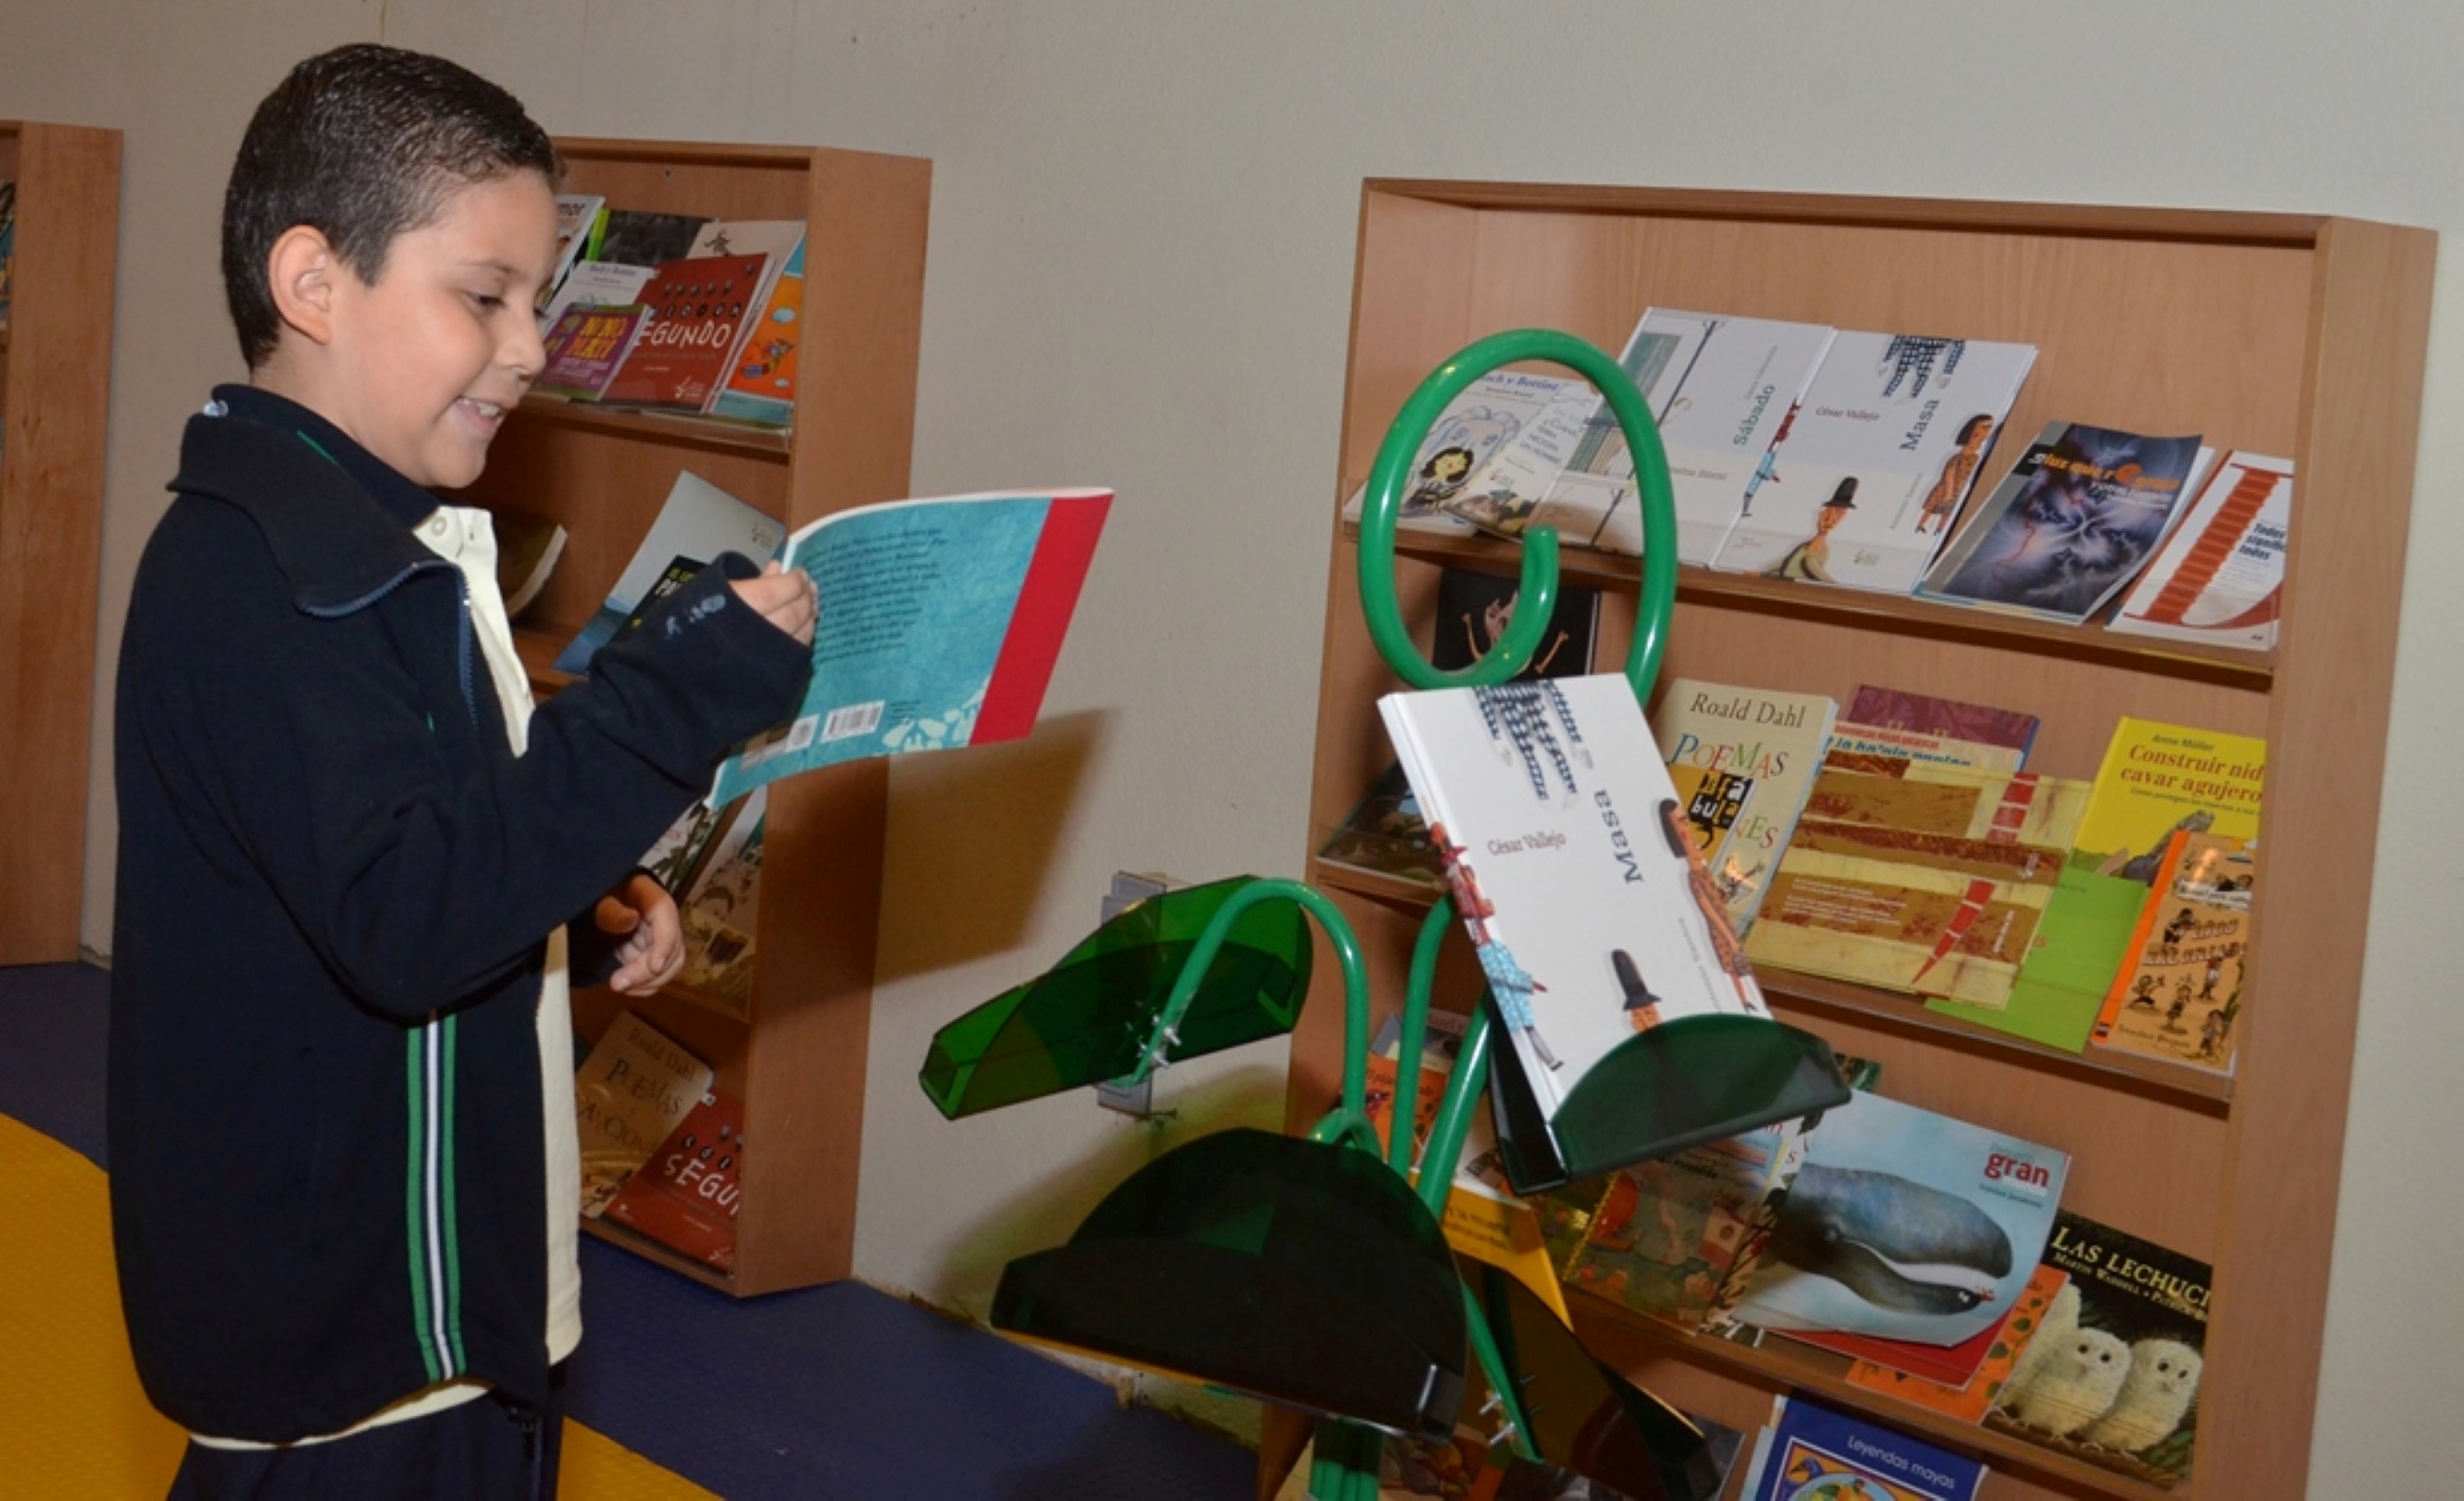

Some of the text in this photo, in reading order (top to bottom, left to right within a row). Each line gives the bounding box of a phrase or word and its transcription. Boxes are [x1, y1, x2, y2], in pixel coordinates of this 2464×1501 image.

[1733, 383, 1776, 445] Sábado
[1815, 406, 1880, 421] César Vallejo
[1900, 398, 1940, 451] Masa
[1690, 692, 1807, 729] Roald Dahl
[1670, 732, 1790, 780] POEMAS
[2129, 743, 2227, 775] Construir
[2121, 766, 2263, 802] cavar agujero
[1487, 832, 1567, 856] César Vallejo
[1593, 788, 1644, 884] Masa
[1984, 1152, 2051, 1188] gran
[1847, 1434, 1956, 1490] Leyendas mayas
